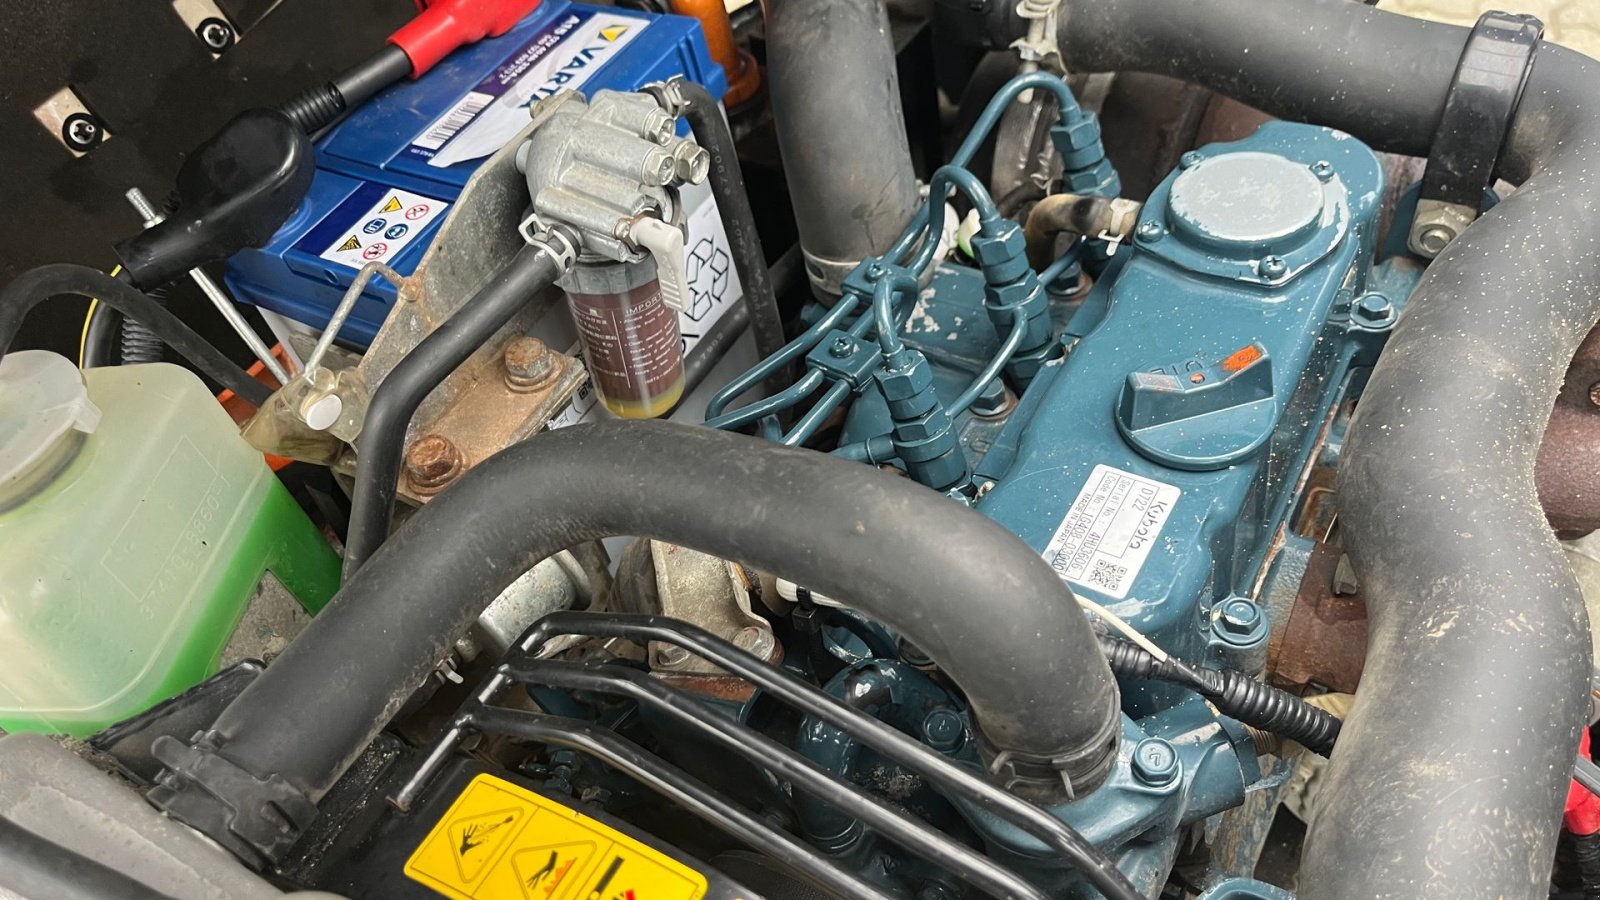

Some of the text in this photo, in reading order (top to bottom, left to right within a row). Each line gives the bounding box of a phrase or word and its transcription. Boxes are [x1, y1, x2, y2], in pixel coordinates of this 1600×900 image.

[553, 15, 581, 35] A15
[518, 46, 606, 109] VARTA
[1100, 475, 1116, 493] Code
[1110, 479, 1131, 503] Serial
[1132, 487, 1154, 512] D722
[1056, 493, 1091, 543] MADE IN JAPAN
[1128, 500, 1168, 550] Kubota
[1072, 531, 1101, 570] 4HU3606
